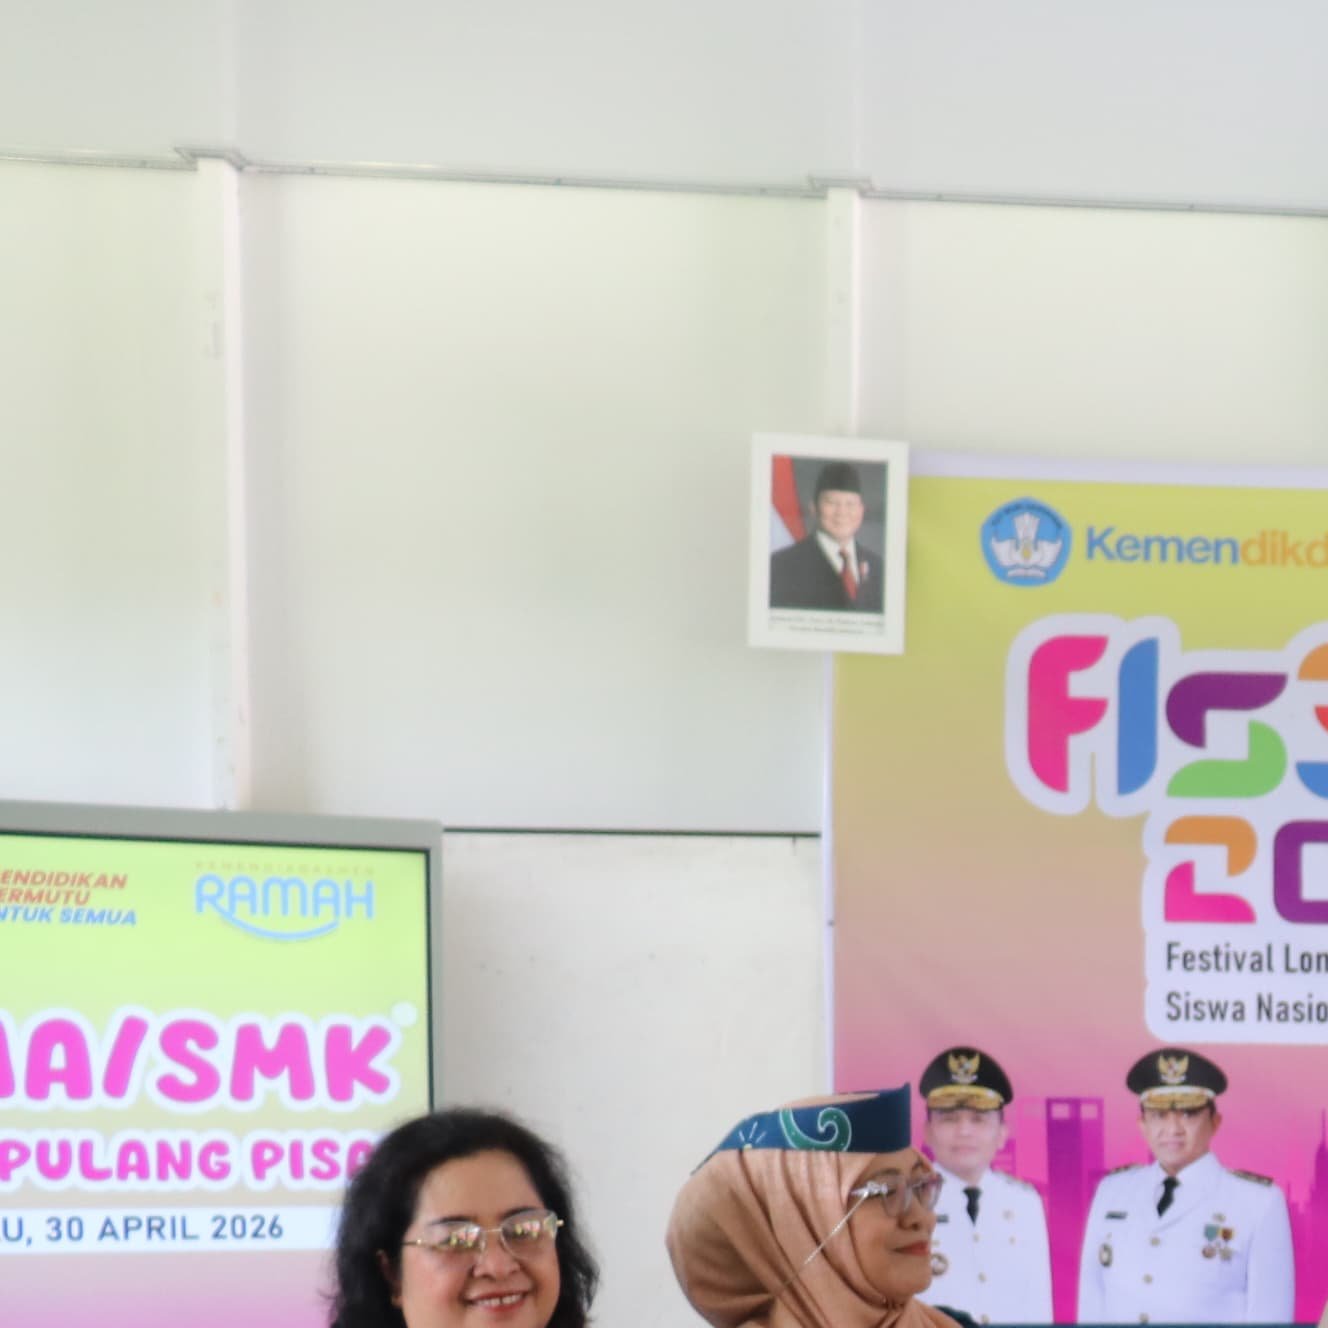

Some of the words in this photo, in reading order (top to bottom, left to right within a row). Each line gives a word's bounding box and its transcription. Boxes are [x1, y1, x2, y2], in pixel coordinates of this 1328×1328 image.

[0, 869, 128, 889] ENDIDIKAN
[0, 887, 91, 906] ERMUTU
[194, 873, 375, 941] RAMAH
[60, 906, 137, 925] SEMUA
[1166, 941, 1275, 974] Festival
[1166, 991, 1246, 1023] Siswa
[0, 1138, 231, 1182] PULANG
[251, 1138, 379, 1182] PISA
[46, 1216, 84, 1242] 30
[97, 1215, 199, 1241] APRIL
[211, 1213, 284, 1240] 2026
